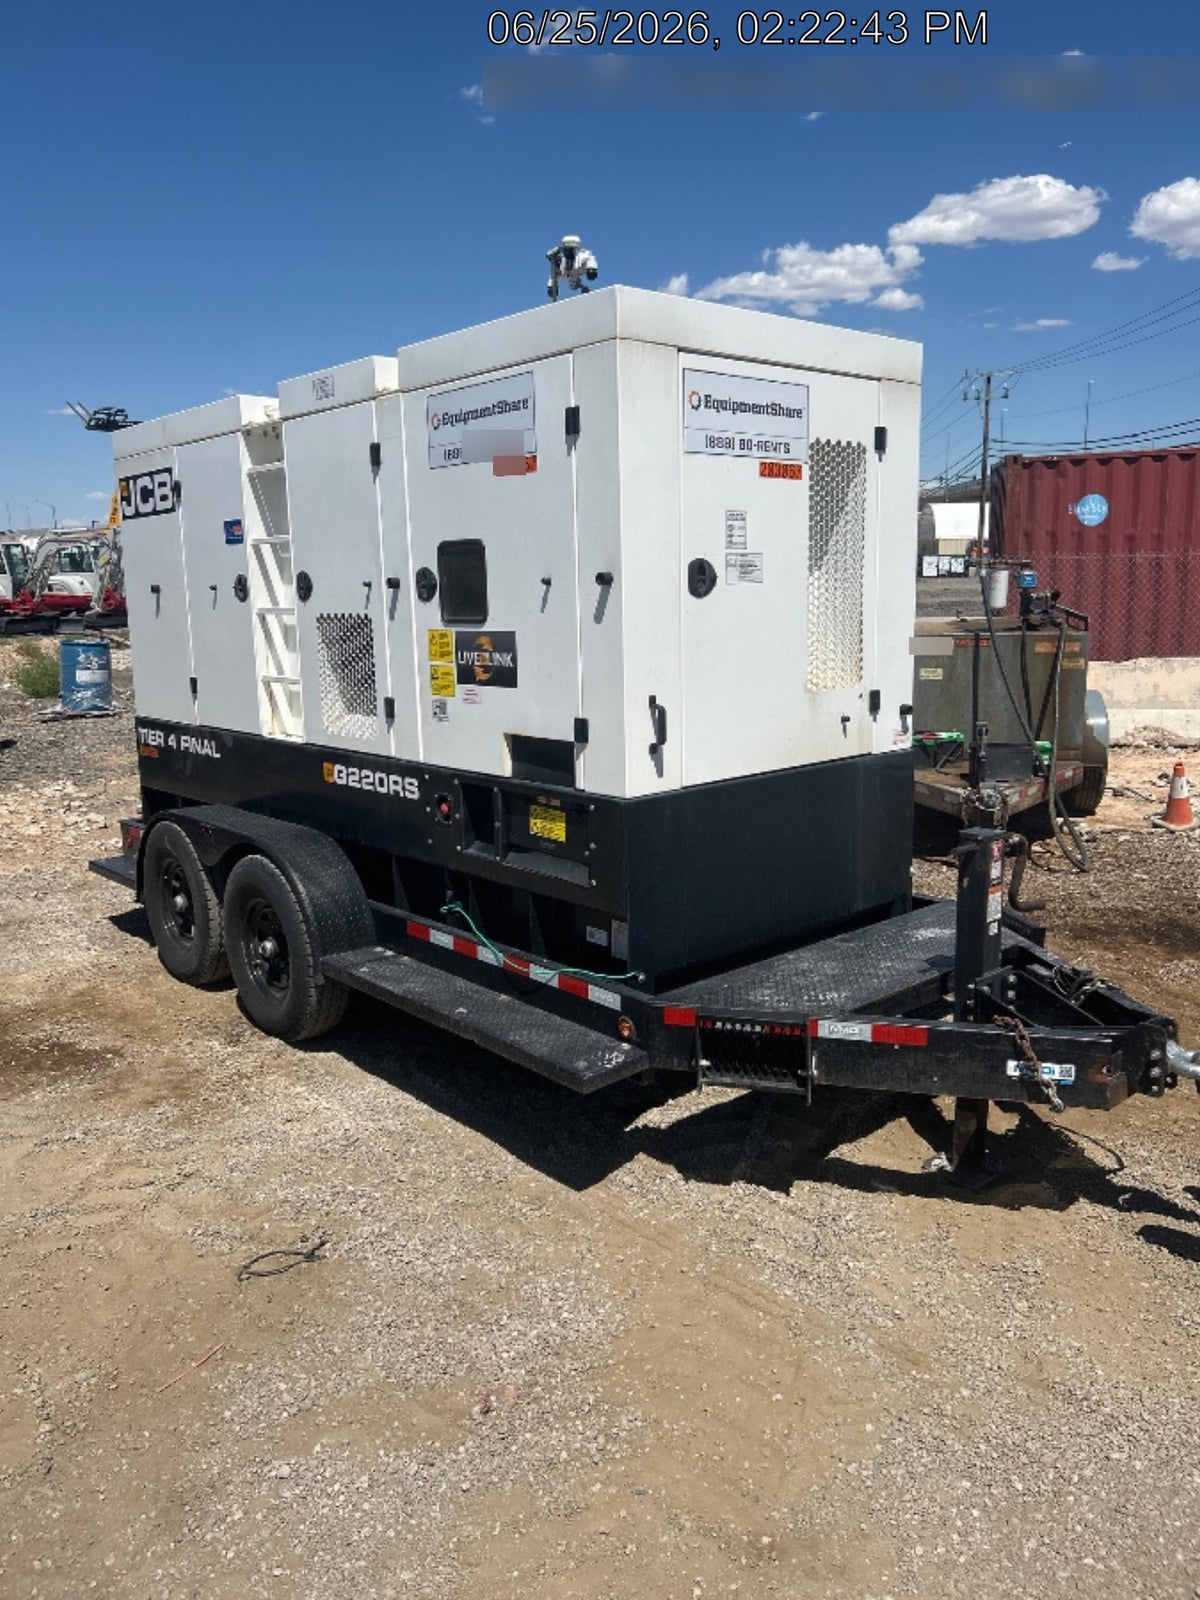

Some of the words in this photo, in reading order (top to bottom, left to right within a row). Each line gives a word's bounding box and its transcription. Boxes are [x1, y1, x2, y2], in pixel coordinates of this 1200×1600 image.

[441, 398, 530, 428] EquipmentShare
[703, 394, 803, 419] EquipmentShare
[121, 472, 173, 516] JCB
[138, 727, 164, 747] TIER
[168, 733, 177, 750] 4
[180, 735, 221, 758] FINAL
[334, 763, 420, 800] G220RS
